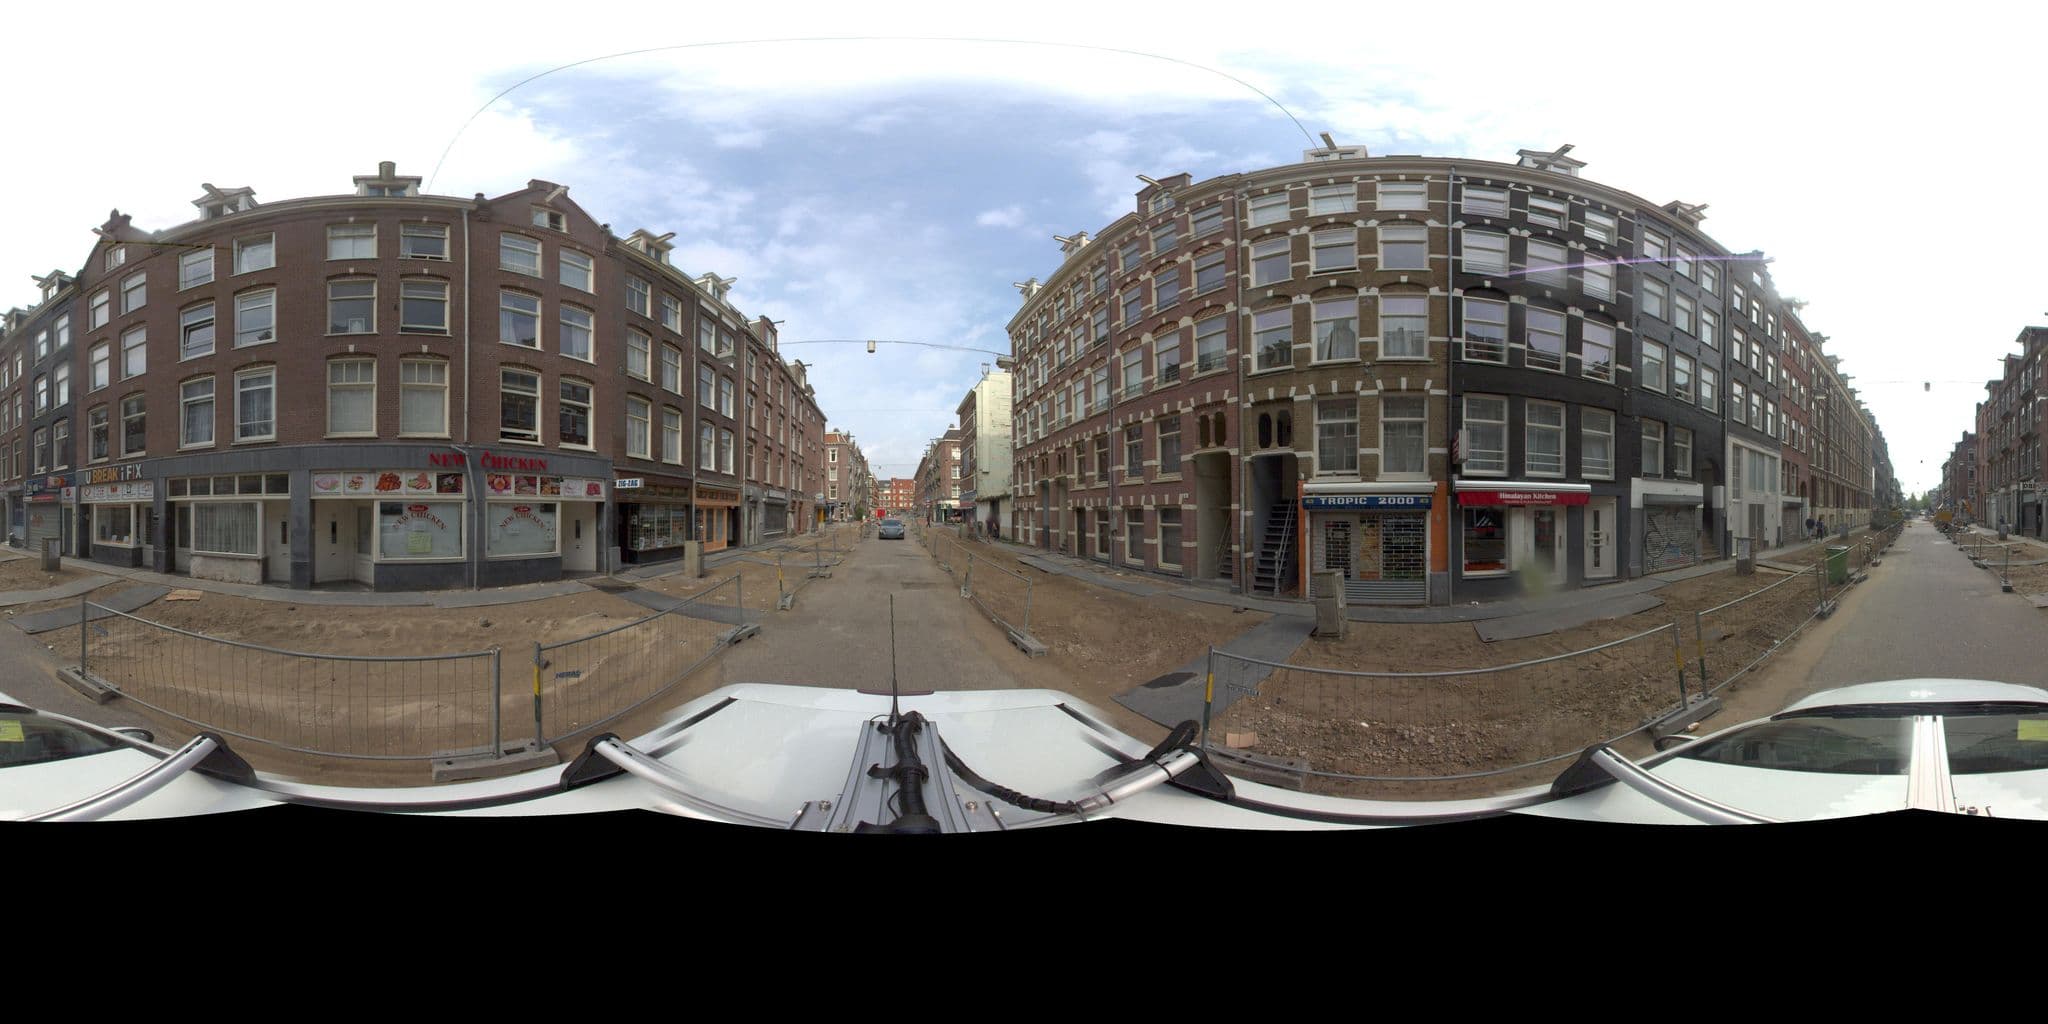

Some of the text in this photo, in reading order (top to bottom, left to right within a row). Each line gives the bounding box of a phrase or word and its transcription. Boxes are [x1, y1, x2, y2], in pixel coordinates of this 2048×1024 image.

[428, 450, 548, 471] NEW CHICKEN
[85, 471, 91, 484] U
[92, 467, 118, 484] BREAK
[1320, 497, 1367, 505] TROPIC
[1378, 497, 1415, 505] 2000
[1499, 492, 1532, 501] Himalayan
